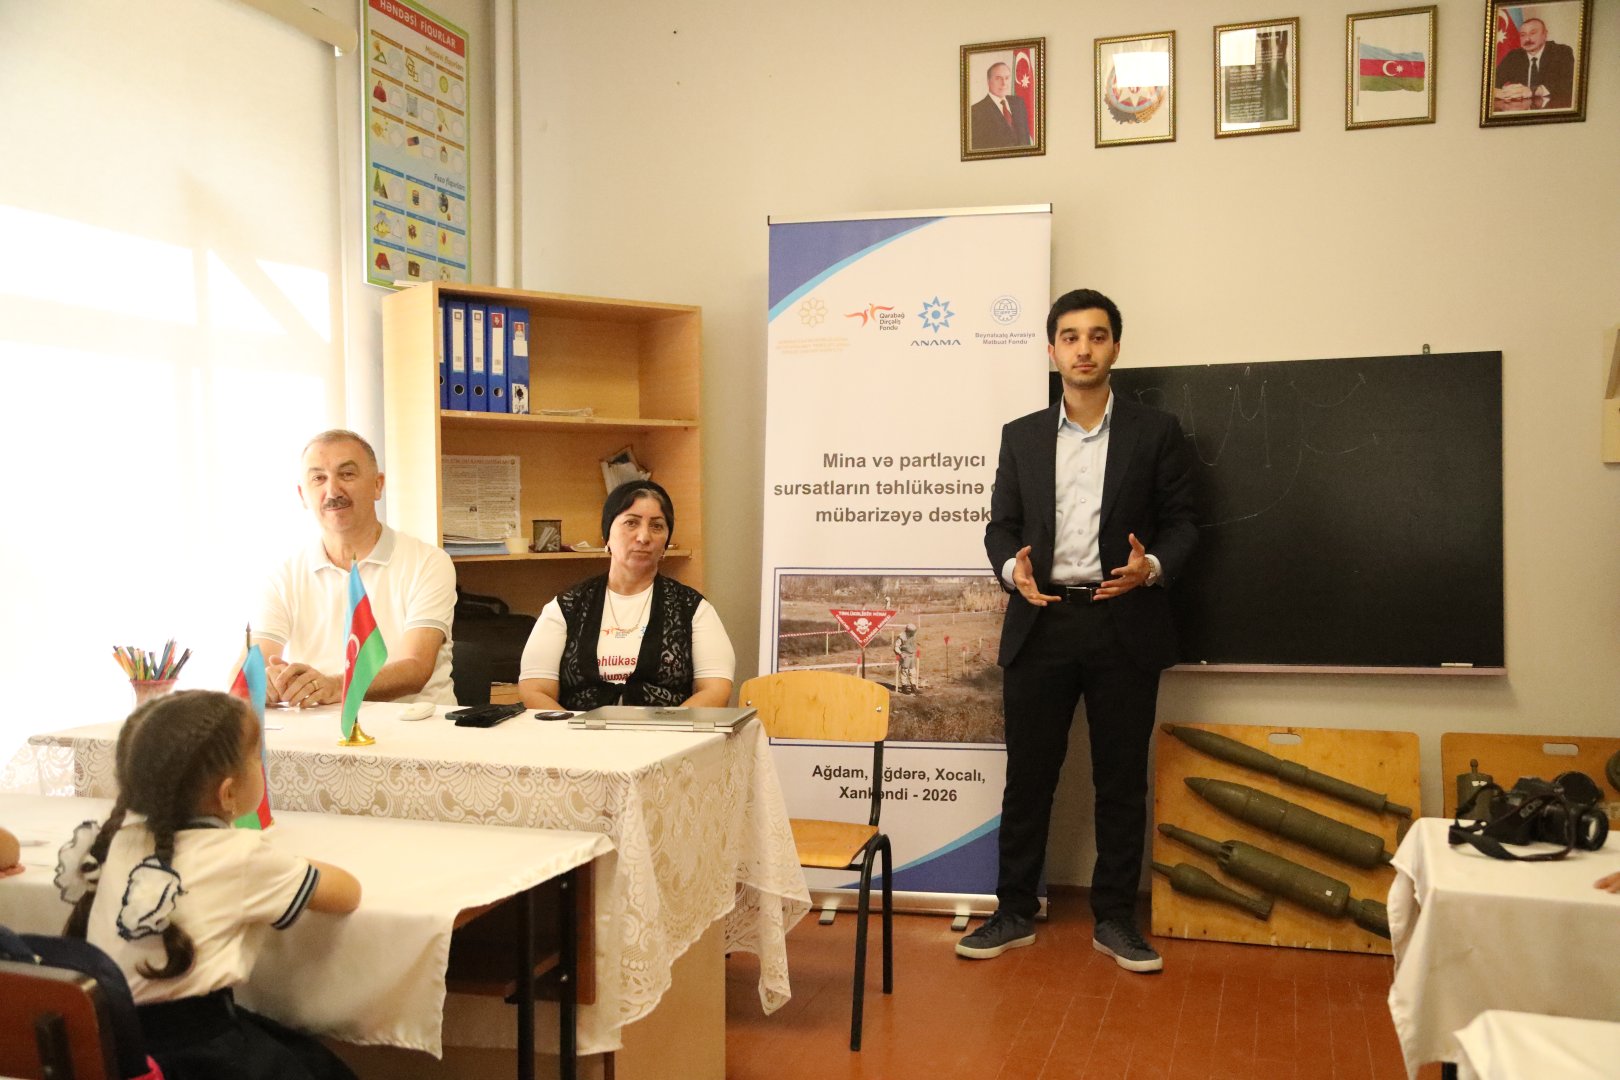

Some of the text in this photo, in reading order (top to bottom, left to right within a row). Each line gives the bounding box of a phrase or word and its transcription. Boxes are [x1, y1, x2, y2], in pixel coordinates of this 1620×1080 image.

[379, 0, 456, 49] HƏNDƏSİ FİQURLAR
[879, 312, 905, 320] Qarabağ
[910, 339, 961, 347] ANAMA
[823, 452, 986, 472] Mina və partlayıcı
[774, 480, 870, 496] sursatların
[876, 479, 985, 495] təhlükəsinə
[815, 506, 991, 526] mübarizəyə dəstək
[597, 655, 637, 667] əhlükəs
[812, 764, 986, 784] Ağdam, ğdərə, Xocalı,
[922, 788, 958, 802] 2026
